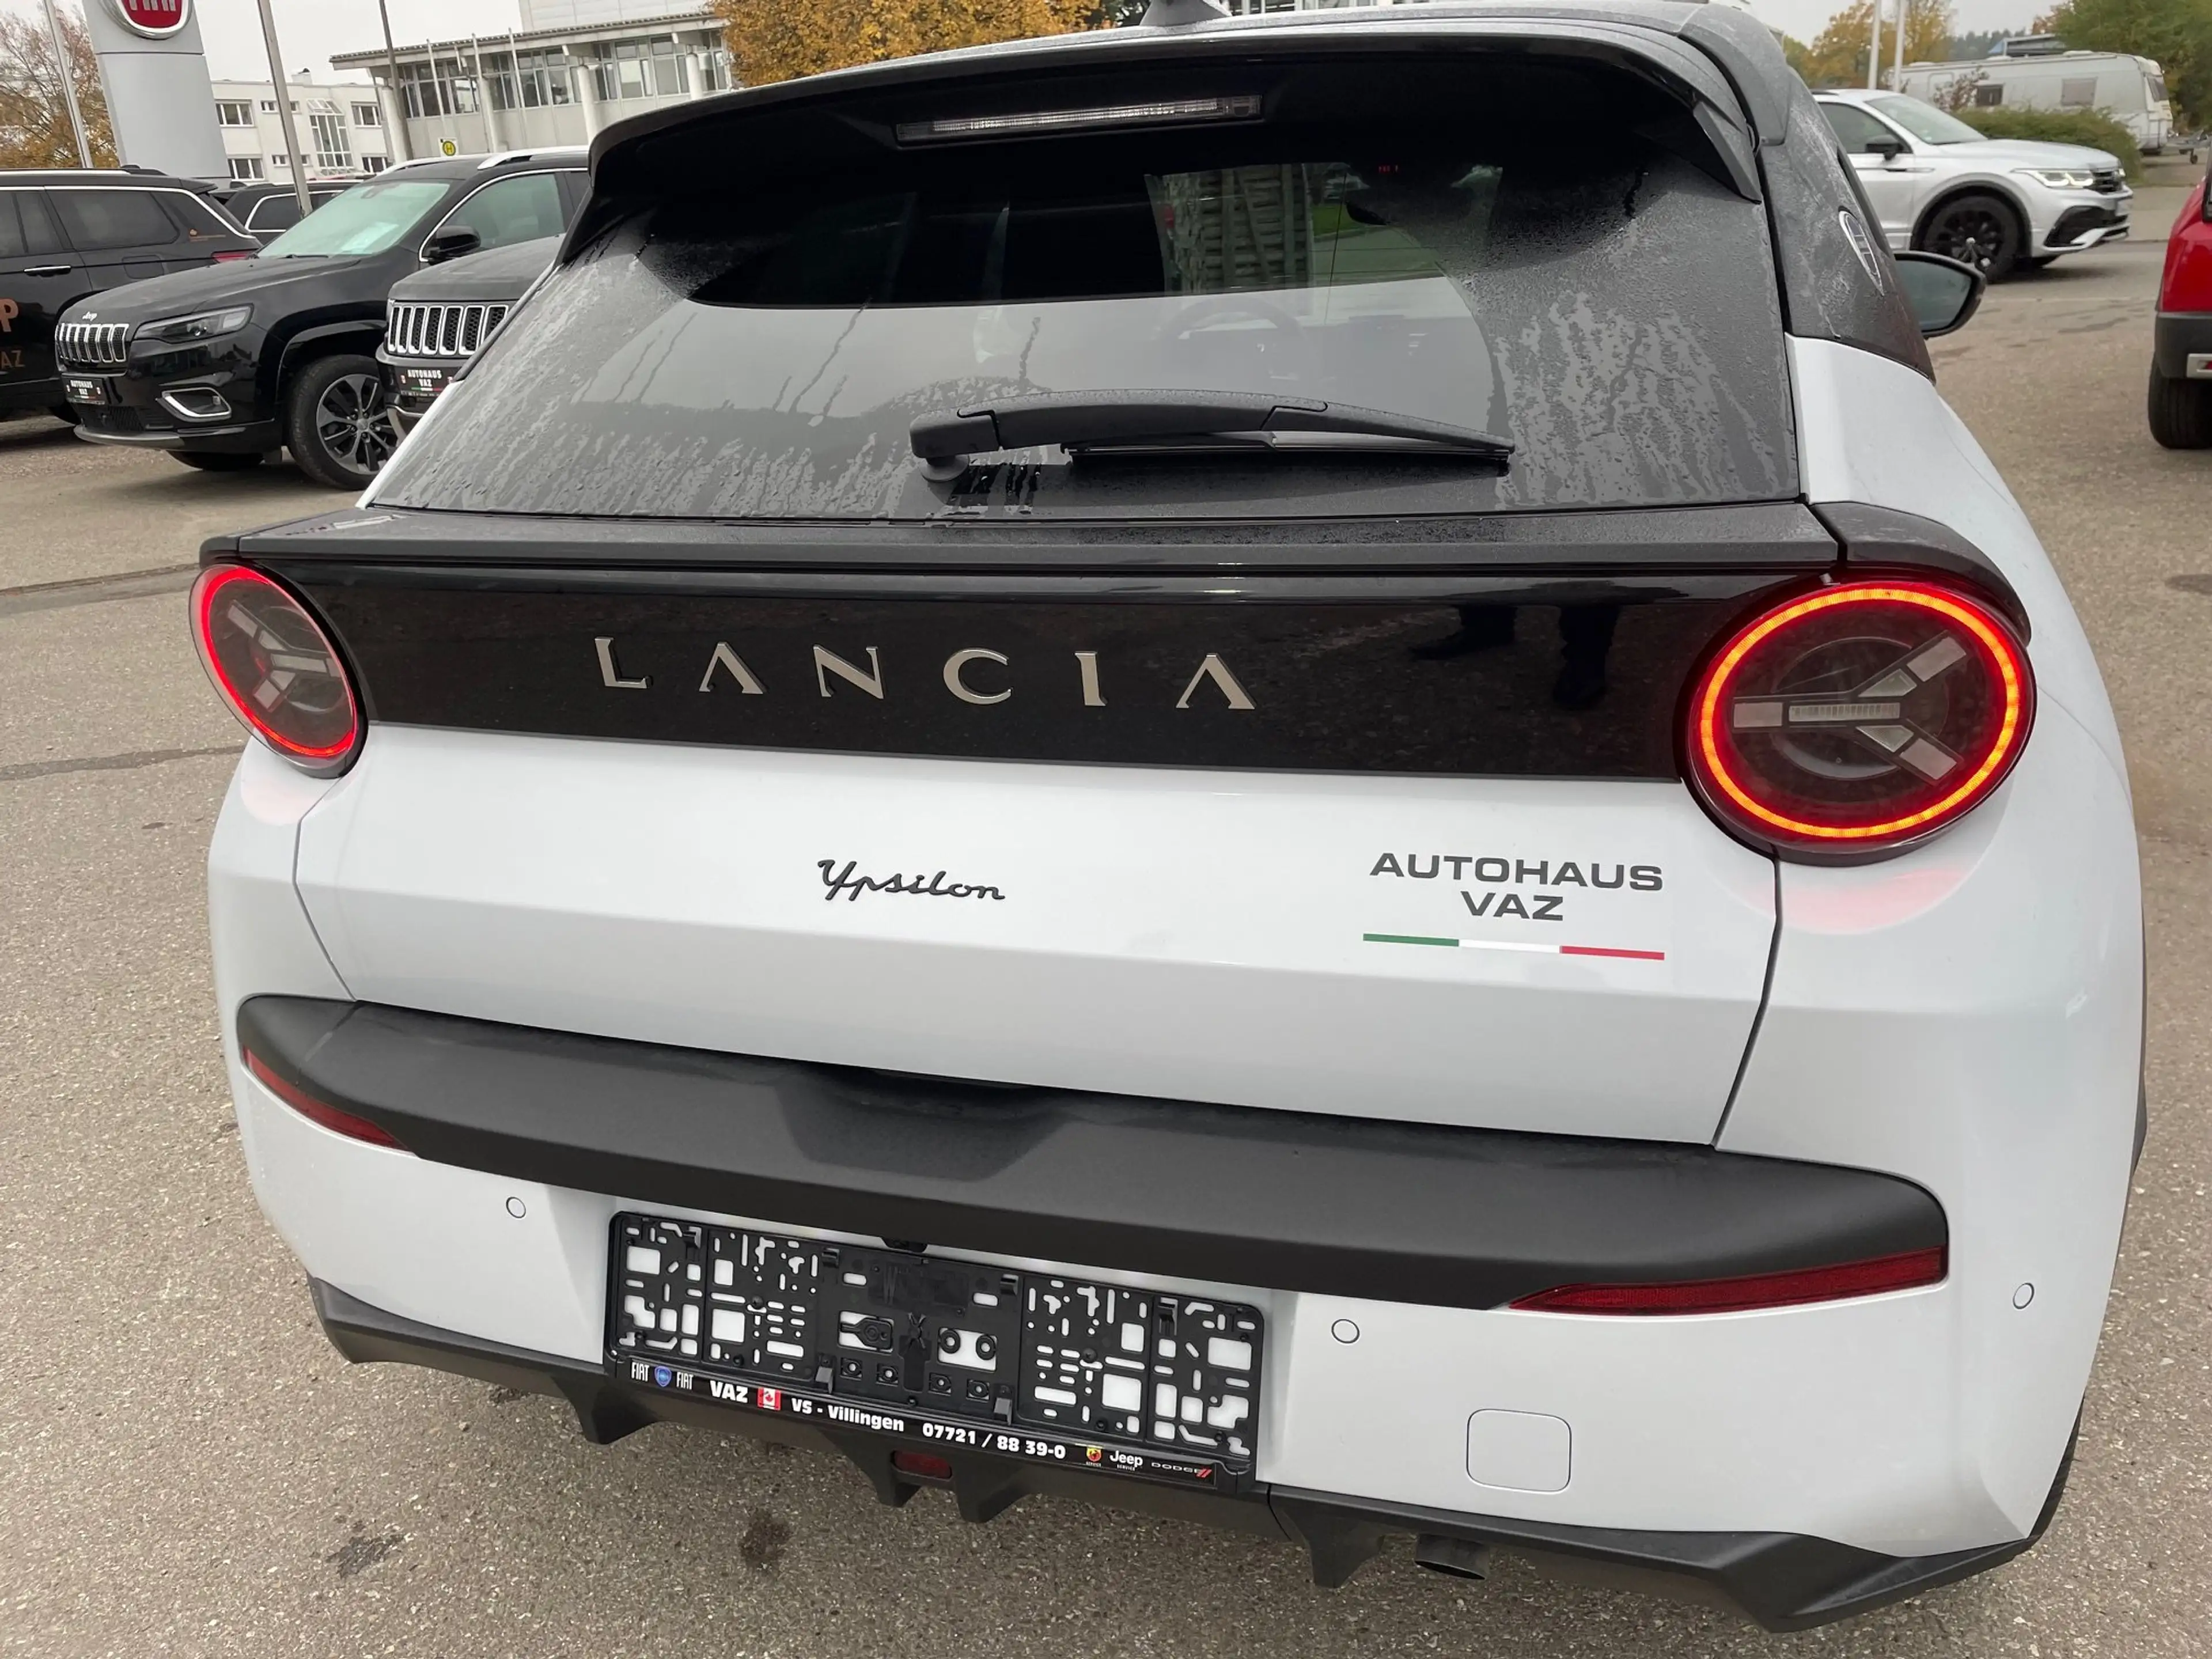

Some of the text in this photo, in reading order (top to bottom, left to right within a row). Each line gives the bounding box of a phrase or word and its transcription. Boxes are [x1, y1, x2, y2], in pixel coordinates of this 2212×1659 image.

[594, 636, 1255, 710] LANCIA
[817, 859, 1005, 901] Ypsilon
[1369, 853, 1663, 891] AUTOHAUS
[1461, 891, 1563, 921] VAZ
[631, 1362, 649, 1382] FIAT
[676, 1371, 694, 1390] FIAT
[710, 1380, 748, 1403] VAZ
[791, 1397, 812, 1414] VS
[828, 1405, 904, 1432] Villingen
[922, 1423, 976, 1445] 07721
[981, 1433, 993, 1448] /
[997, 1435, 1020, 1452] 88
[1025, 1440, 1066, 1459] 39-0
[1109, 1450, 1143, 1467] Jeep
